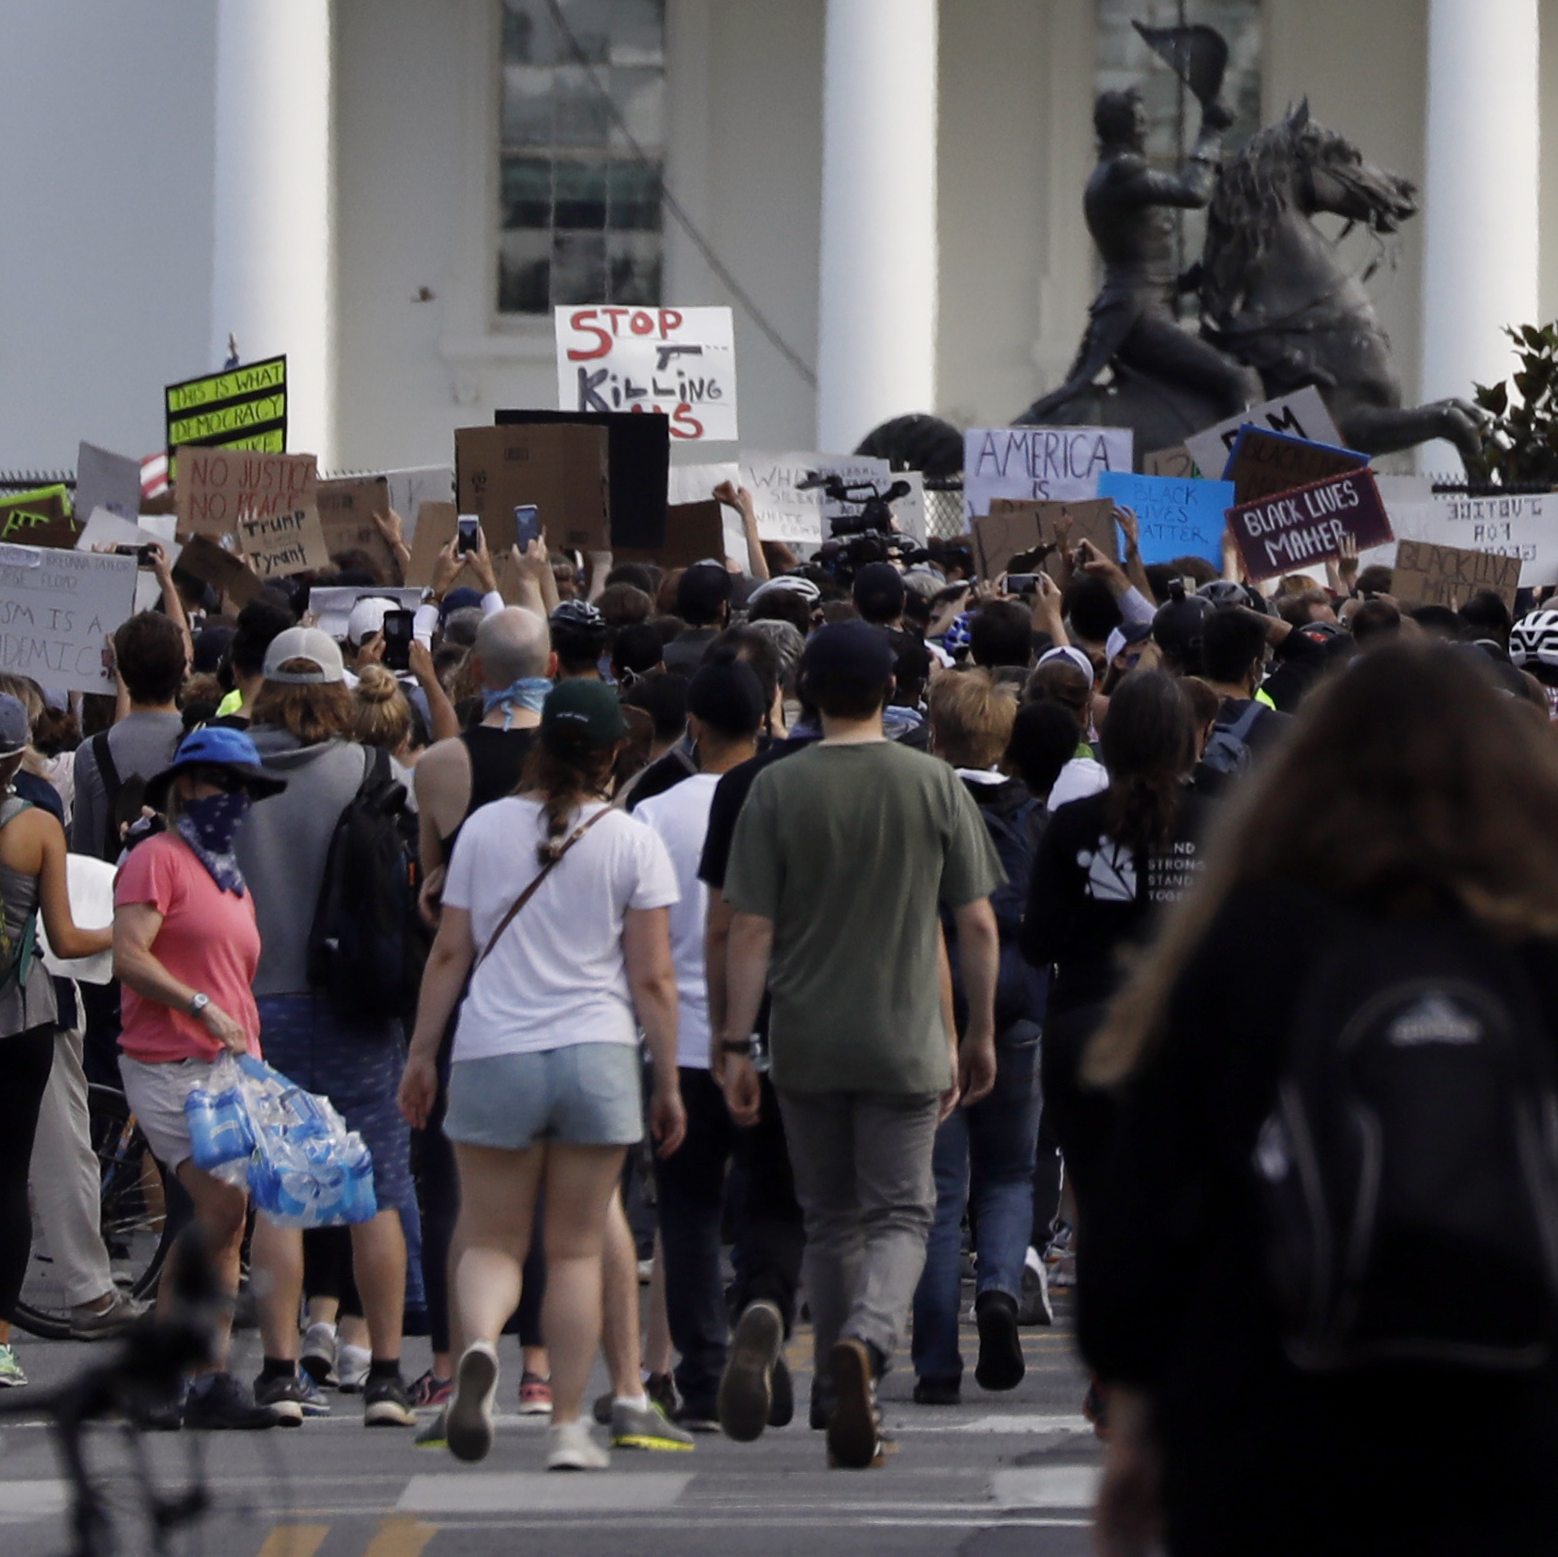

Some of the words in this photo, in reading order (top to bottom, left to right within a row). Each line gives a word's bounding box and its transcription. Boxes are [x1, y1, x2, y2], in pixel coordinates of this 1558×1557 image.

[567, 308, 683, 361] STOP
[214, 380, 229, 399] IS
[234, 364, 281, 392] WHAT
[175, 395, 281, 440] DEMOCRACY
[631, 402, 703, 439] S
[975, 431, 1111, 480] AMERICA
[191, 457, 228, 488] NO
[238, 457, 316, 494] JUSTICE
[1032, 481, 1050, 500] IS
[188, 492, 226, 520] NO
[1135, 483, 1199, 506] BLACK
[1243, 499, 1304, 539] BLACK
[1303, 480, 1360, 519] LIVES
[1133, 505, 1189, 524] LIVES
[1143, 523, 1209, 544] ATTER
[250, 543, 307, 575] Tyrant
[1397, 543, 1470, 583] BLACK
[48, 608, 75, 632] IS
[87, 615, 103, 634] A
[1147, 859, 1207, 871] STRONG
[1147, 874, 1194, 886] STAND
